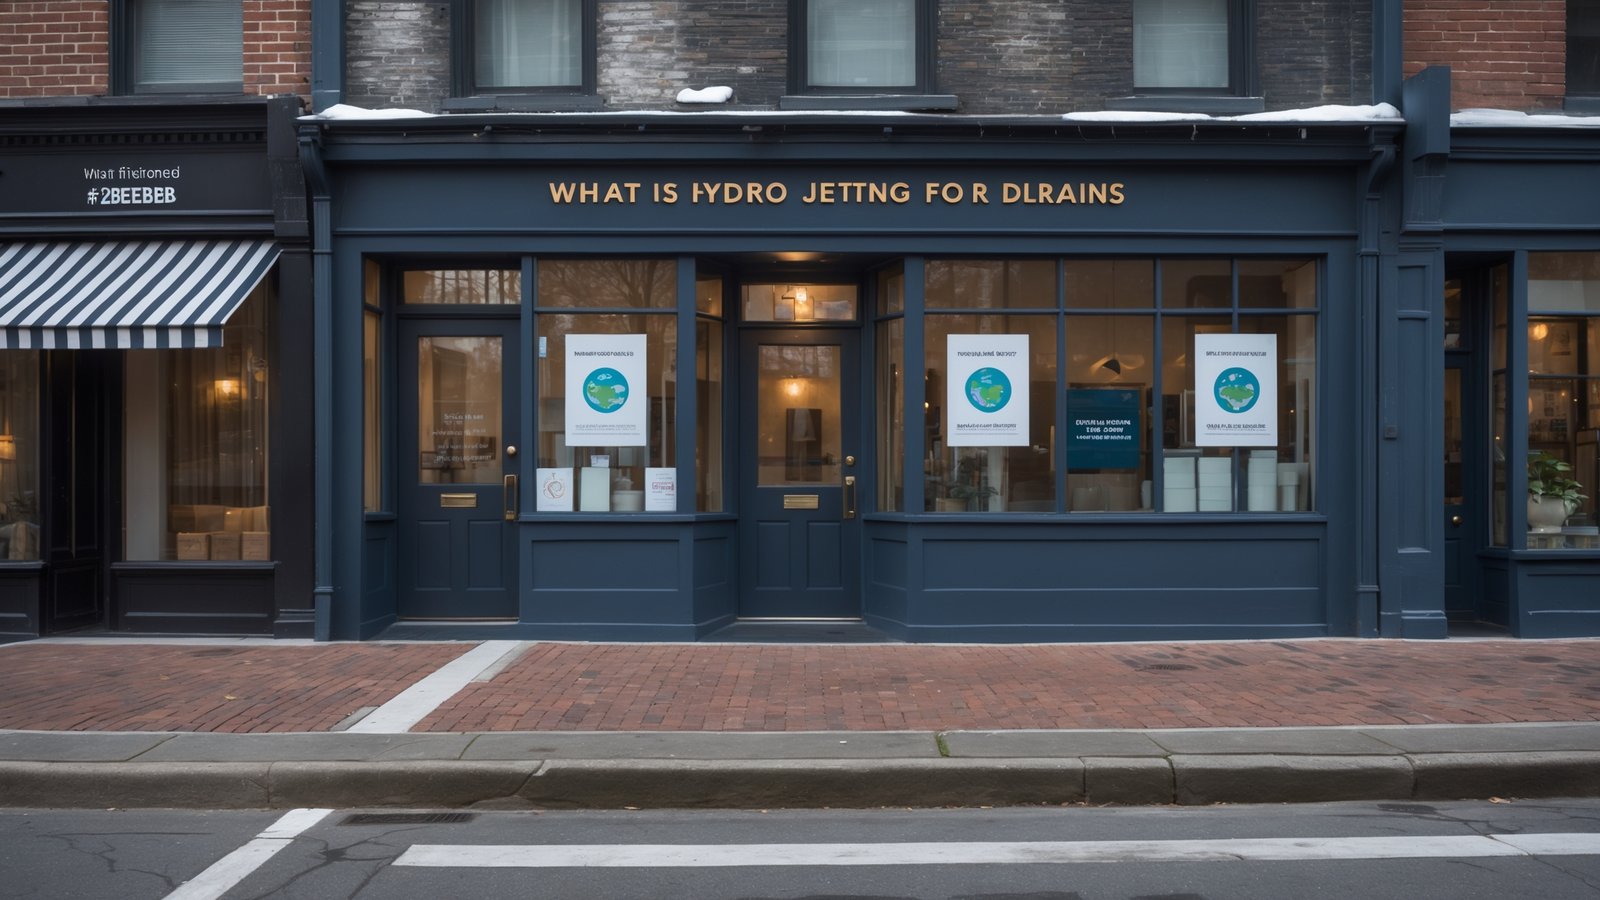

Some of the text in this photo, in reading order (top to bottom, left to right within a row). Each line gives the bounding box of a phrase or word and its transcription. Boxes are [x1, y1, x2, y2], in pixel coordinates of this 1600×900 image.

[549, 182, 641, 204] WHAT
[653, 182, 678, 204] IS
[1002, 182, 1125, 205] DLRAINS
